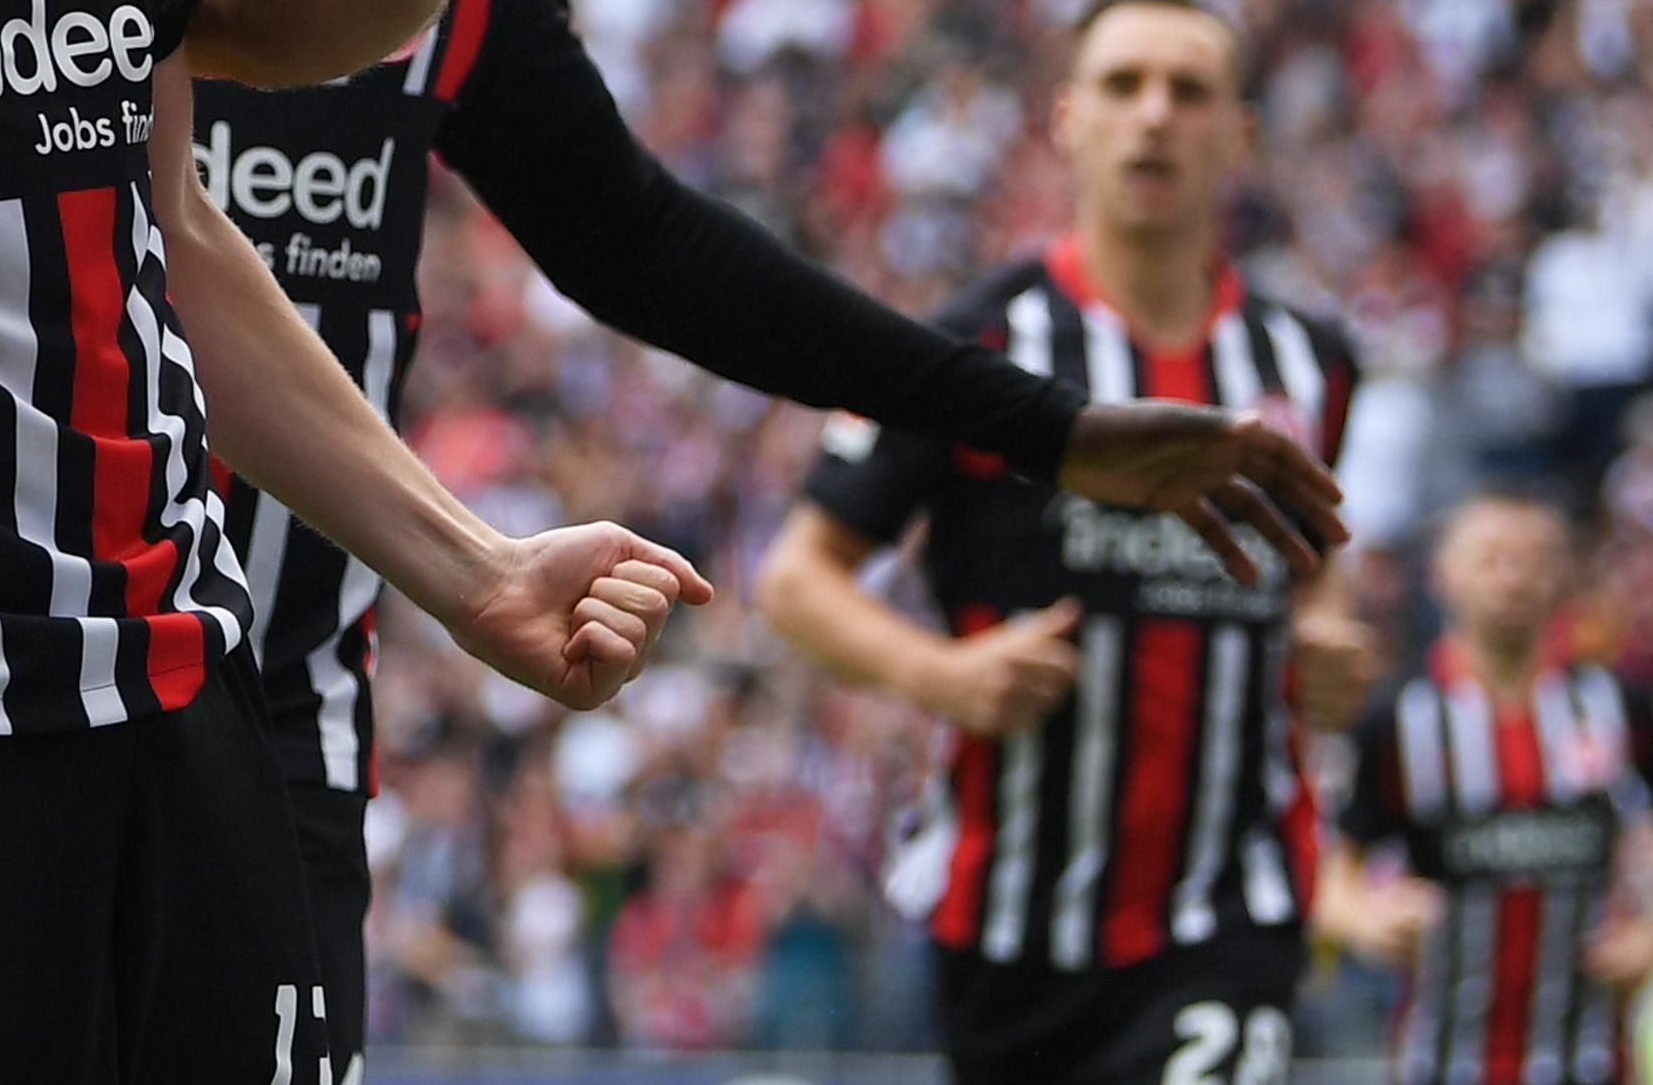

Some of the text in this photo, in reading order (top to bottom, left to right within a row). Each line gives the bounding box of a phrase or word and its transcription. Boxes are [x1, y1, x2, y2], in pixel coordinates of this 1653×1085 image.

[35, 106, 116, 155] Jobs
[192, 119, 396, 231] deed
[285, 233, 383, 283] finden
